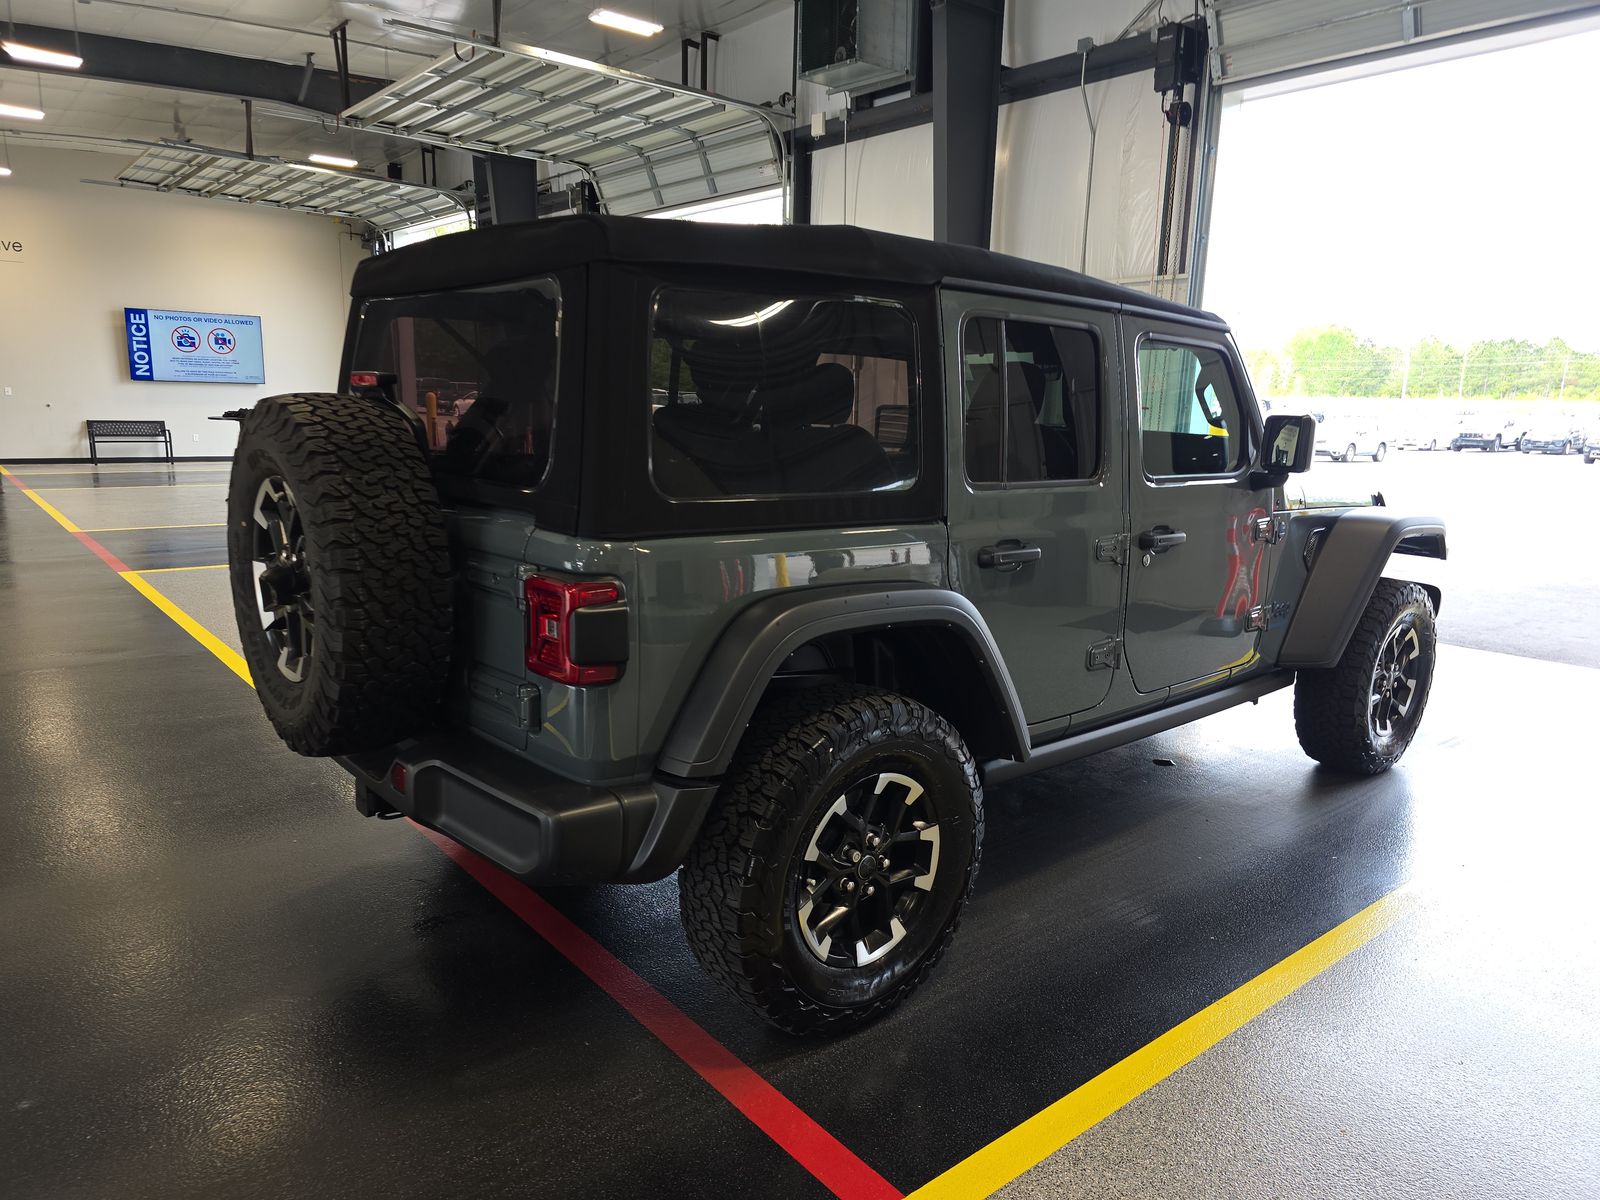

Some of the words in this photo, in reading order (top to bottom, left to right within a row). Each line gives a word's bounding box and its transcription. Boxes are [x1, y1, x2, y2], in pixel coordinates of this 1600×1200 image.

[0, 240, 23, 253] ve
[224, 318, 254, 326] ALLOWED
[130, 313, 150, 376] NOTICE
